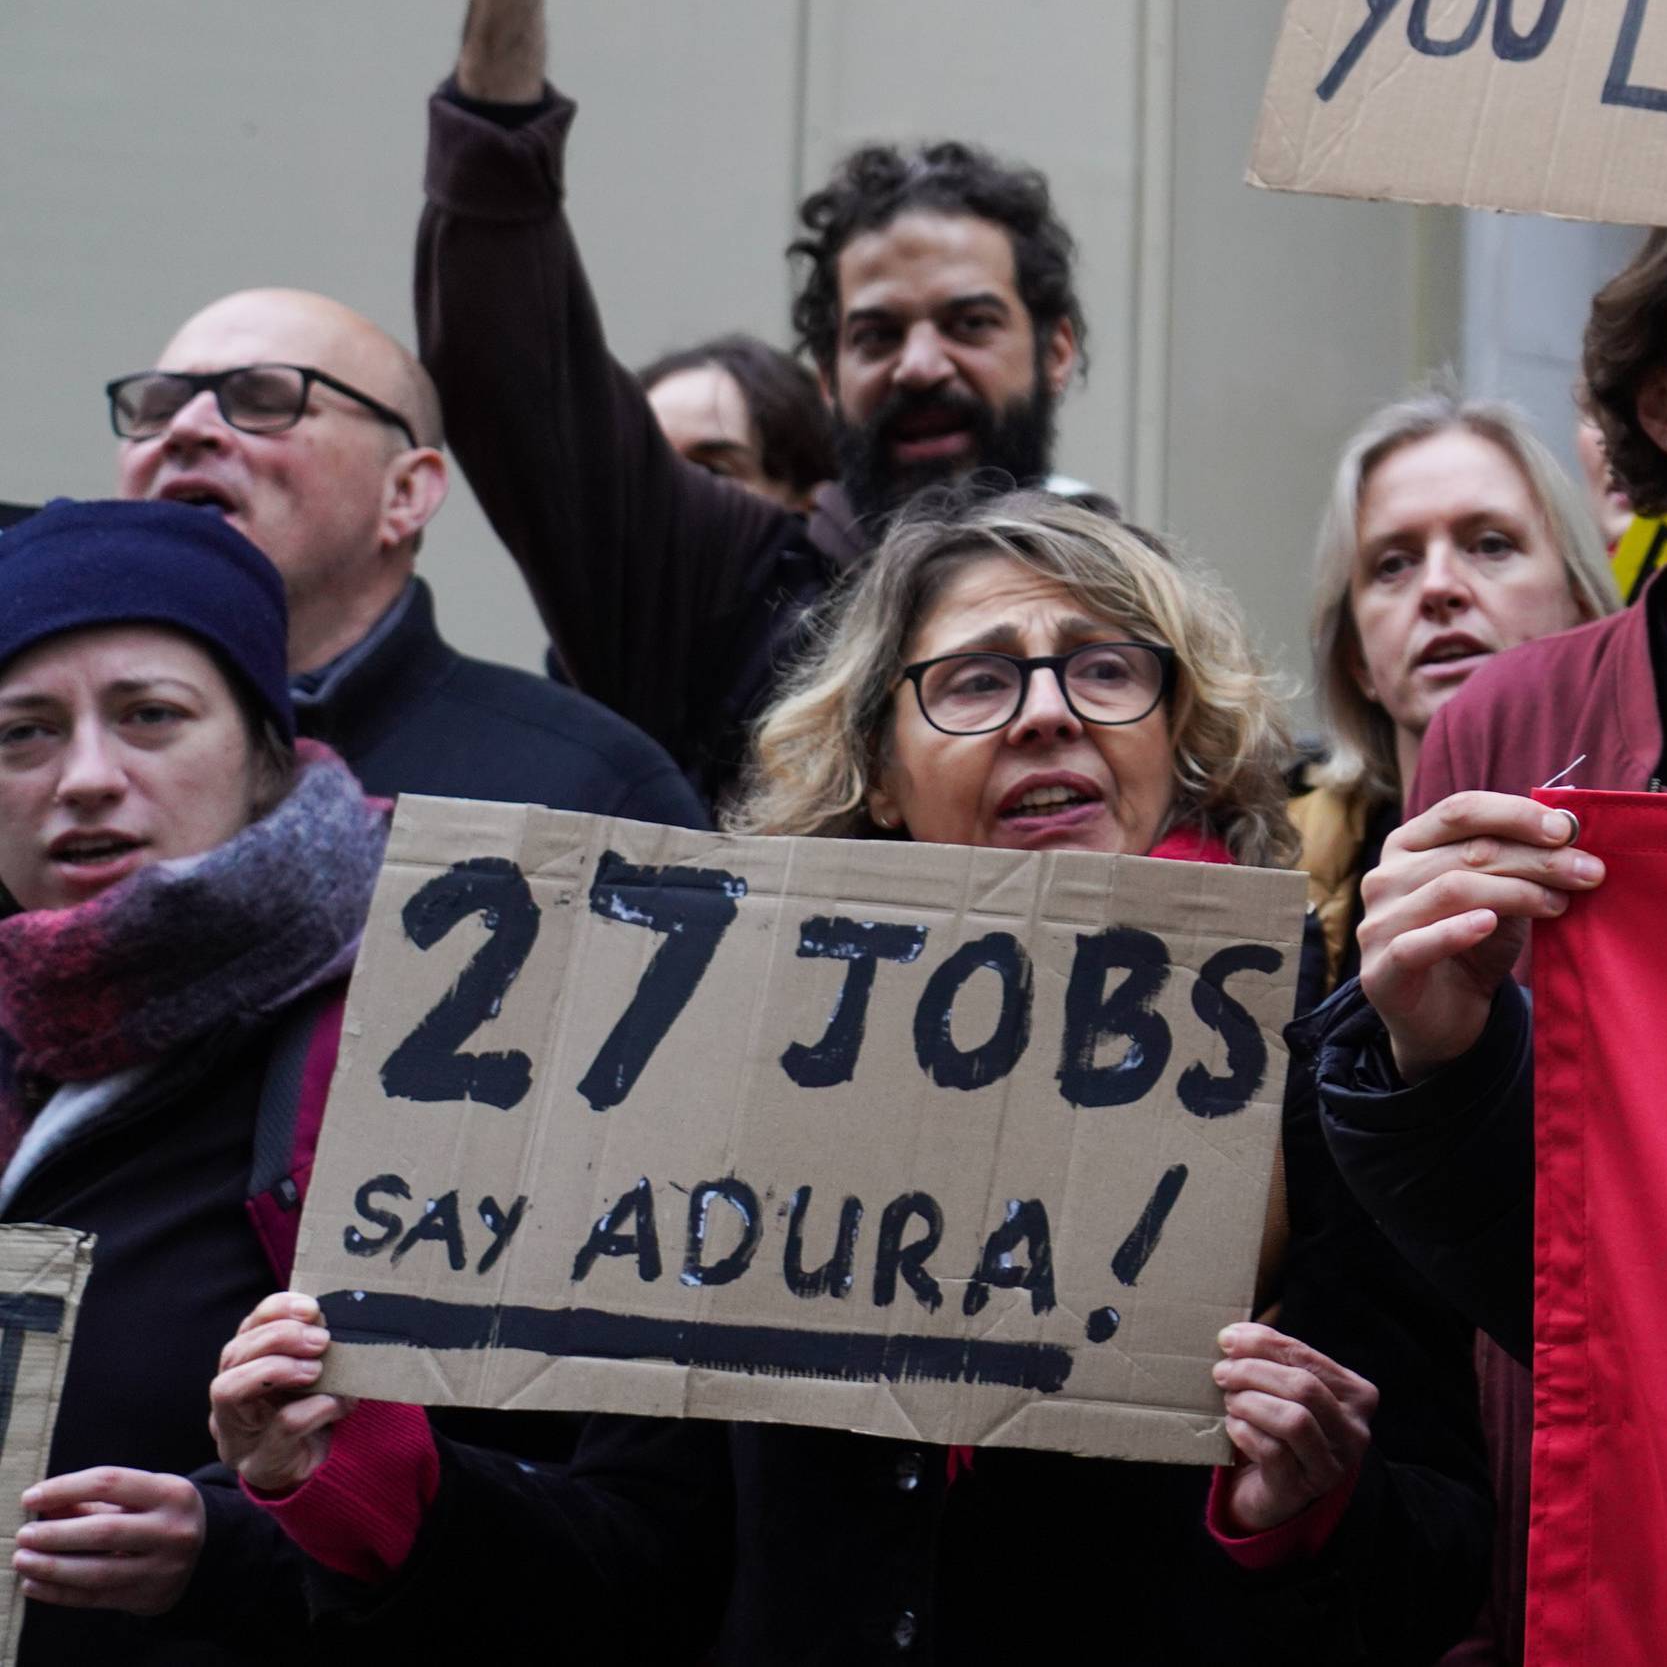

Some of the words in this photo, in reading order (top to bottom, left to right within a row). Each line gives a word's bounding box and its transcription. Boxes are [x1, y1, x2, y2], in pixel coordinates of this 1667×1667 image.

[381, 849, 747, 1112] 27
[779, 914, 1284, 1118] JOBS
[342, 1174, 527, 1284] SAY
[570, 1163, 1188, 1342] ADURA!
